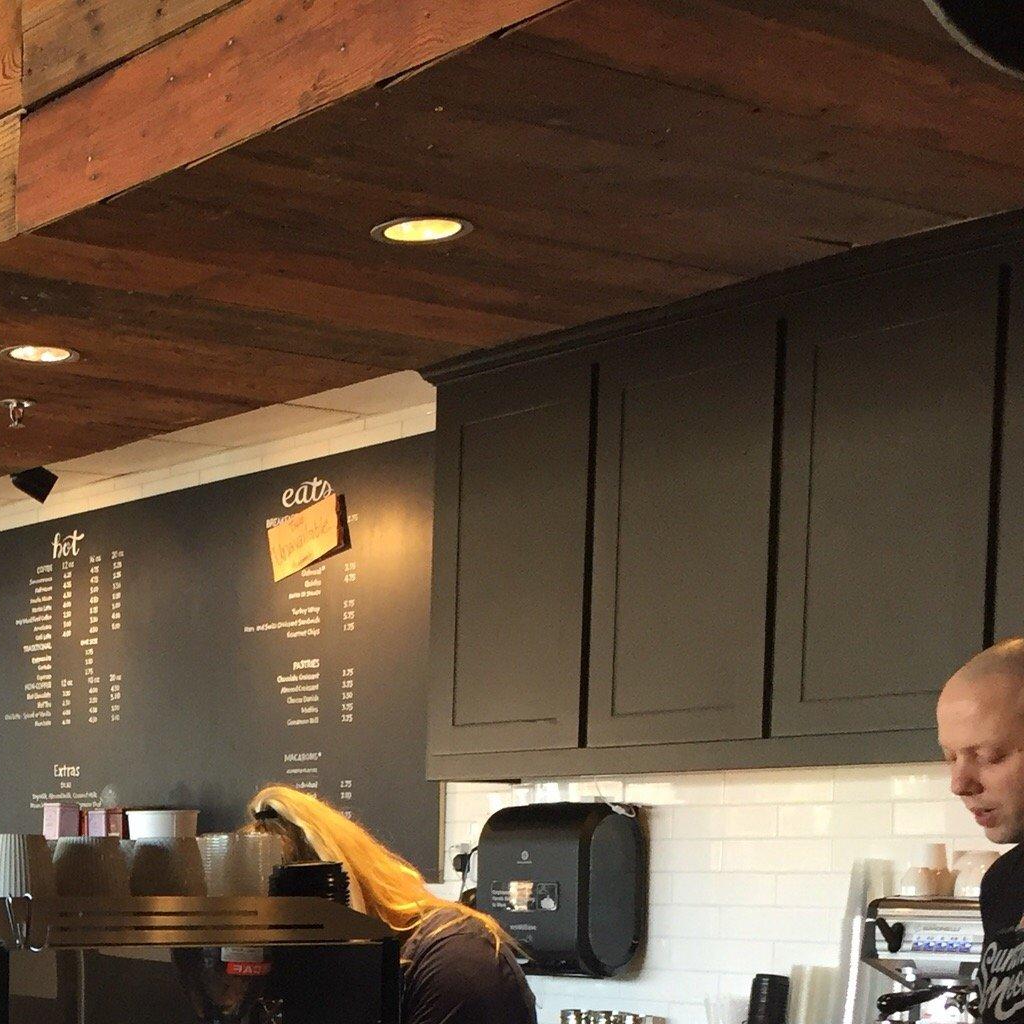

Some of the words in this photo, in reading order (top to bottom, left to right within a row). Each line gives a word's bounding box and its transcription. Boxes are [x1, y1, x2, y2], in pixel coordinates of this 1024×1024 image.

[282, 477, 335, 508] eats
[51, 530, 85, 559] hot
[293, 659, 320, 670] PASTRIES
[53, 764, 80, 777] Extras
